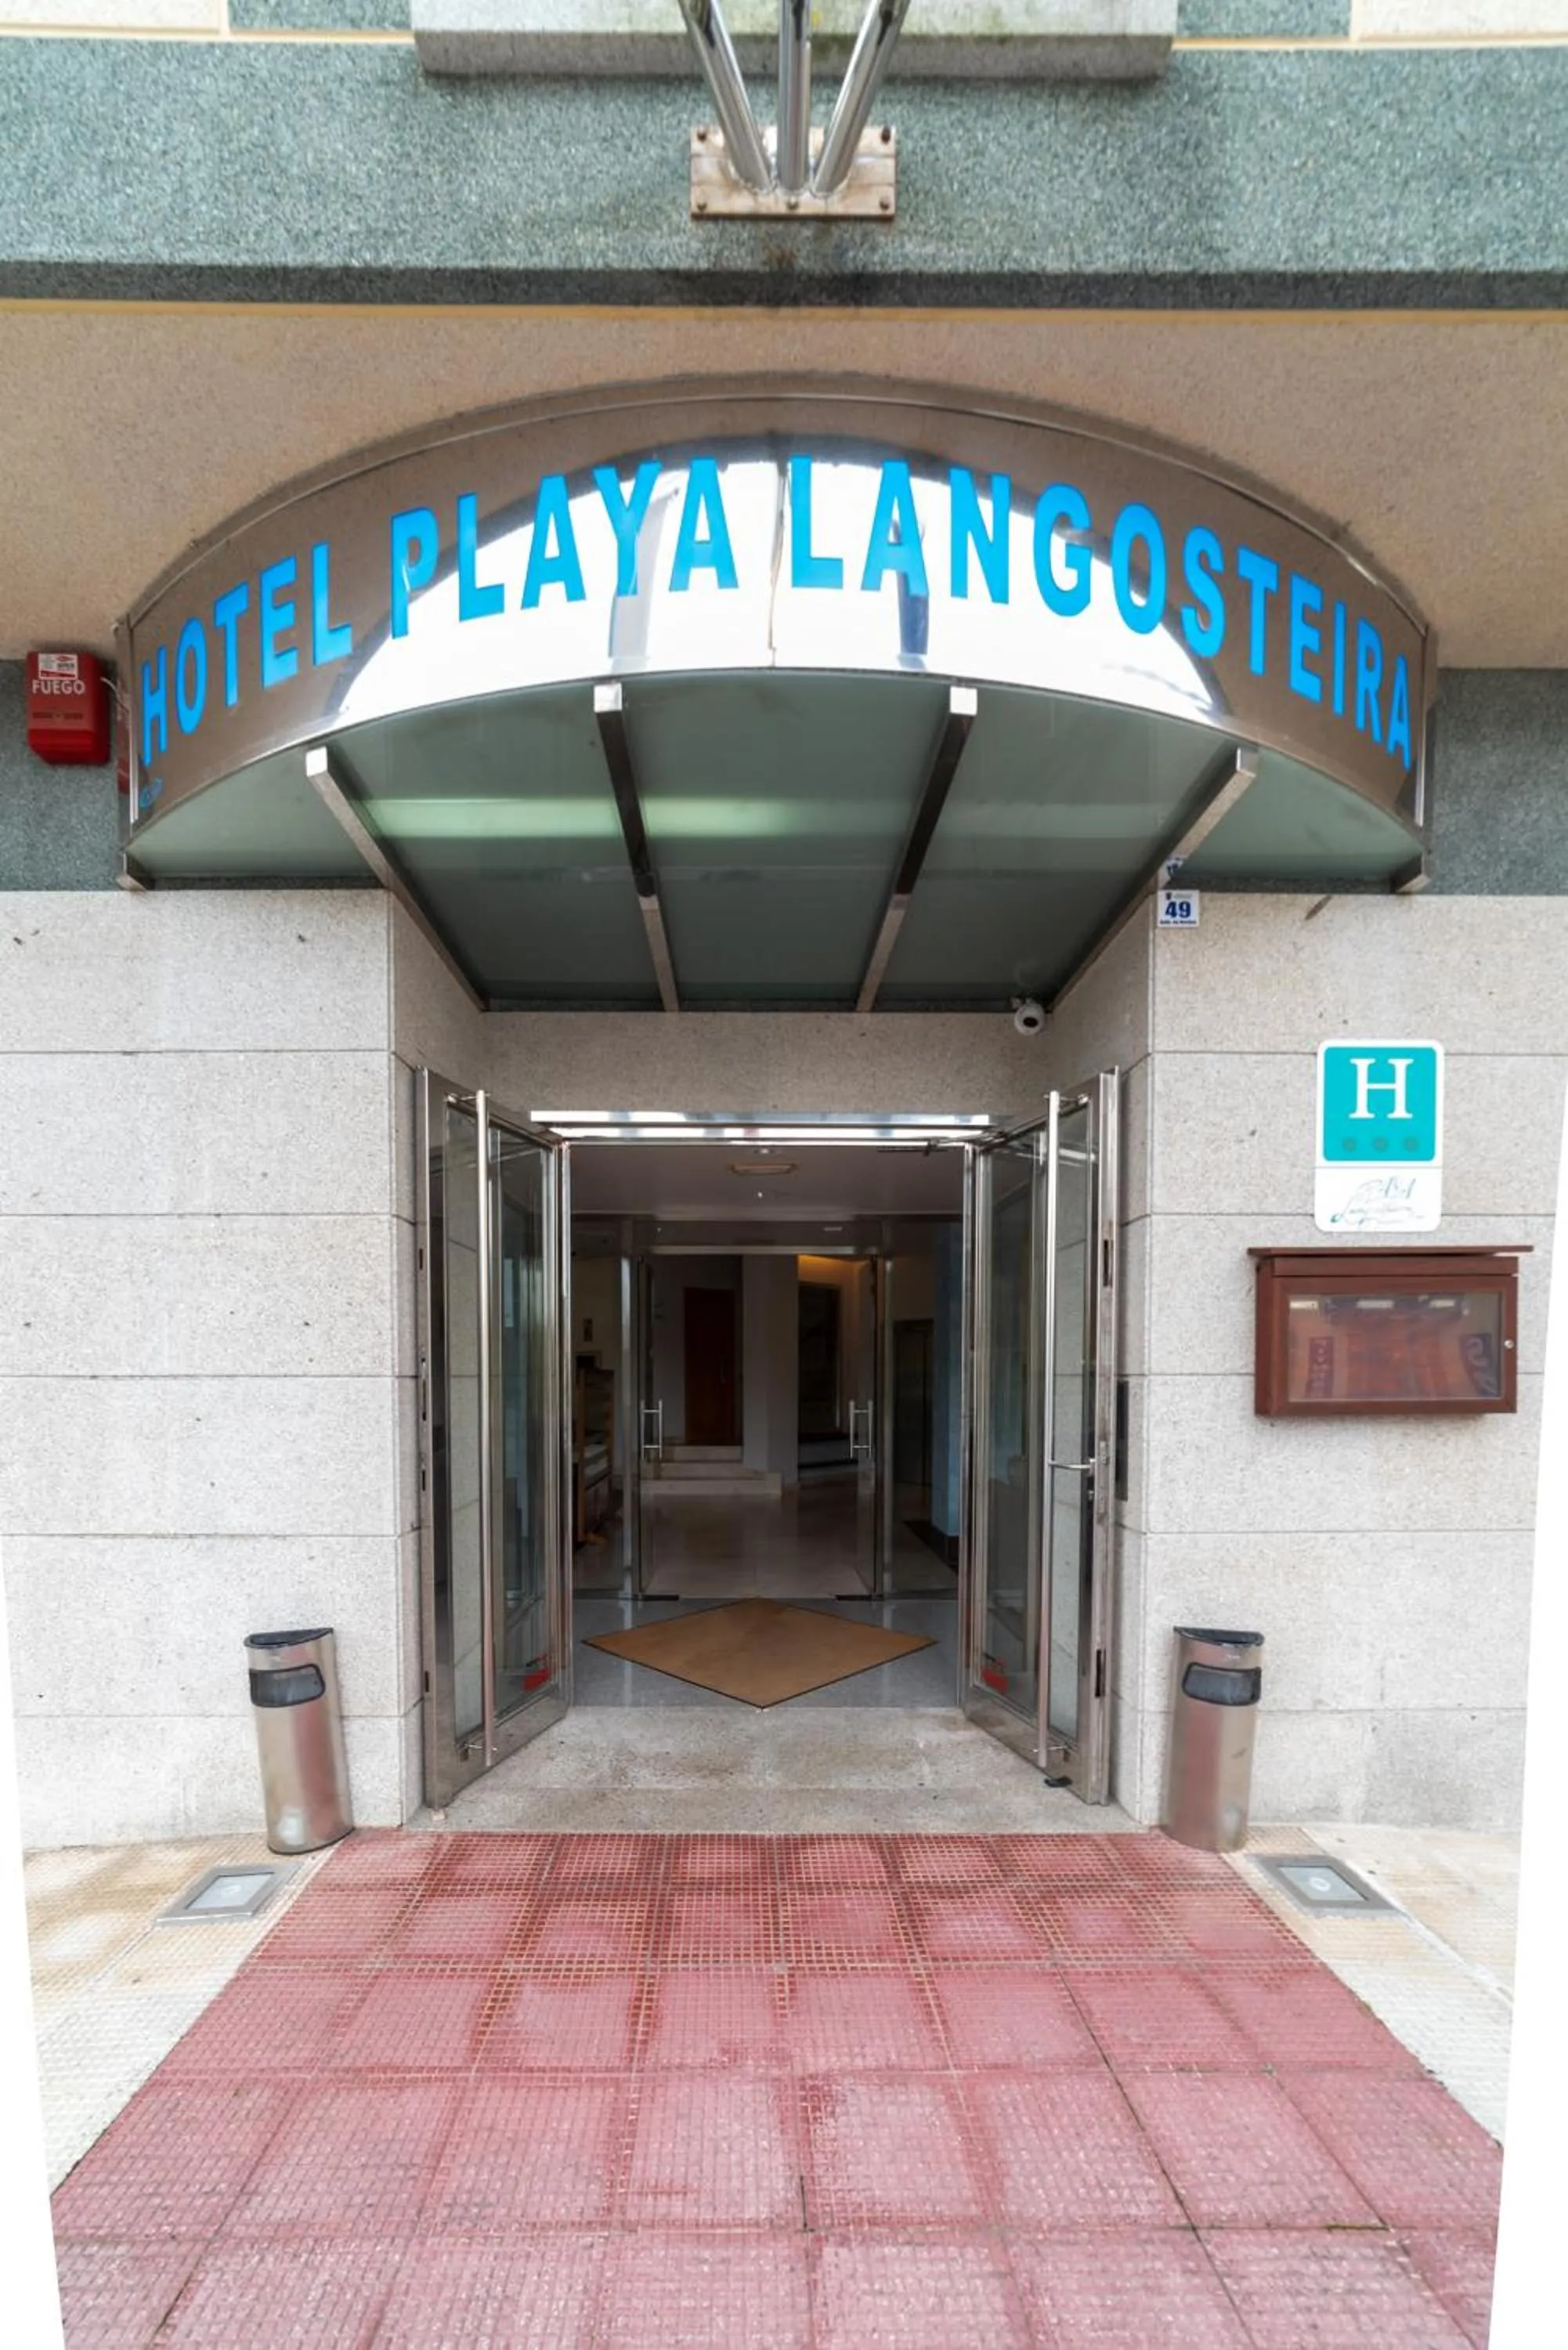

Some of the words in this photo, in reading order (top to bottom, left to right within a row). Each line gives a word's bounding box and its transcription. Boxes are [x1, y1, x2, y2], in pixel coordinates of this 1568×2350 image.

[142, 542, 352, 766] HOTEL
[391, 458, 739, 639] PLAYA
[787, 455, 1411, 770] LANGOSTEIRA
[32, 679, 85, 695] FUEGO
[1165, 901, 1191, 919] 49
[1348, 1058, 1414, 1119] H
